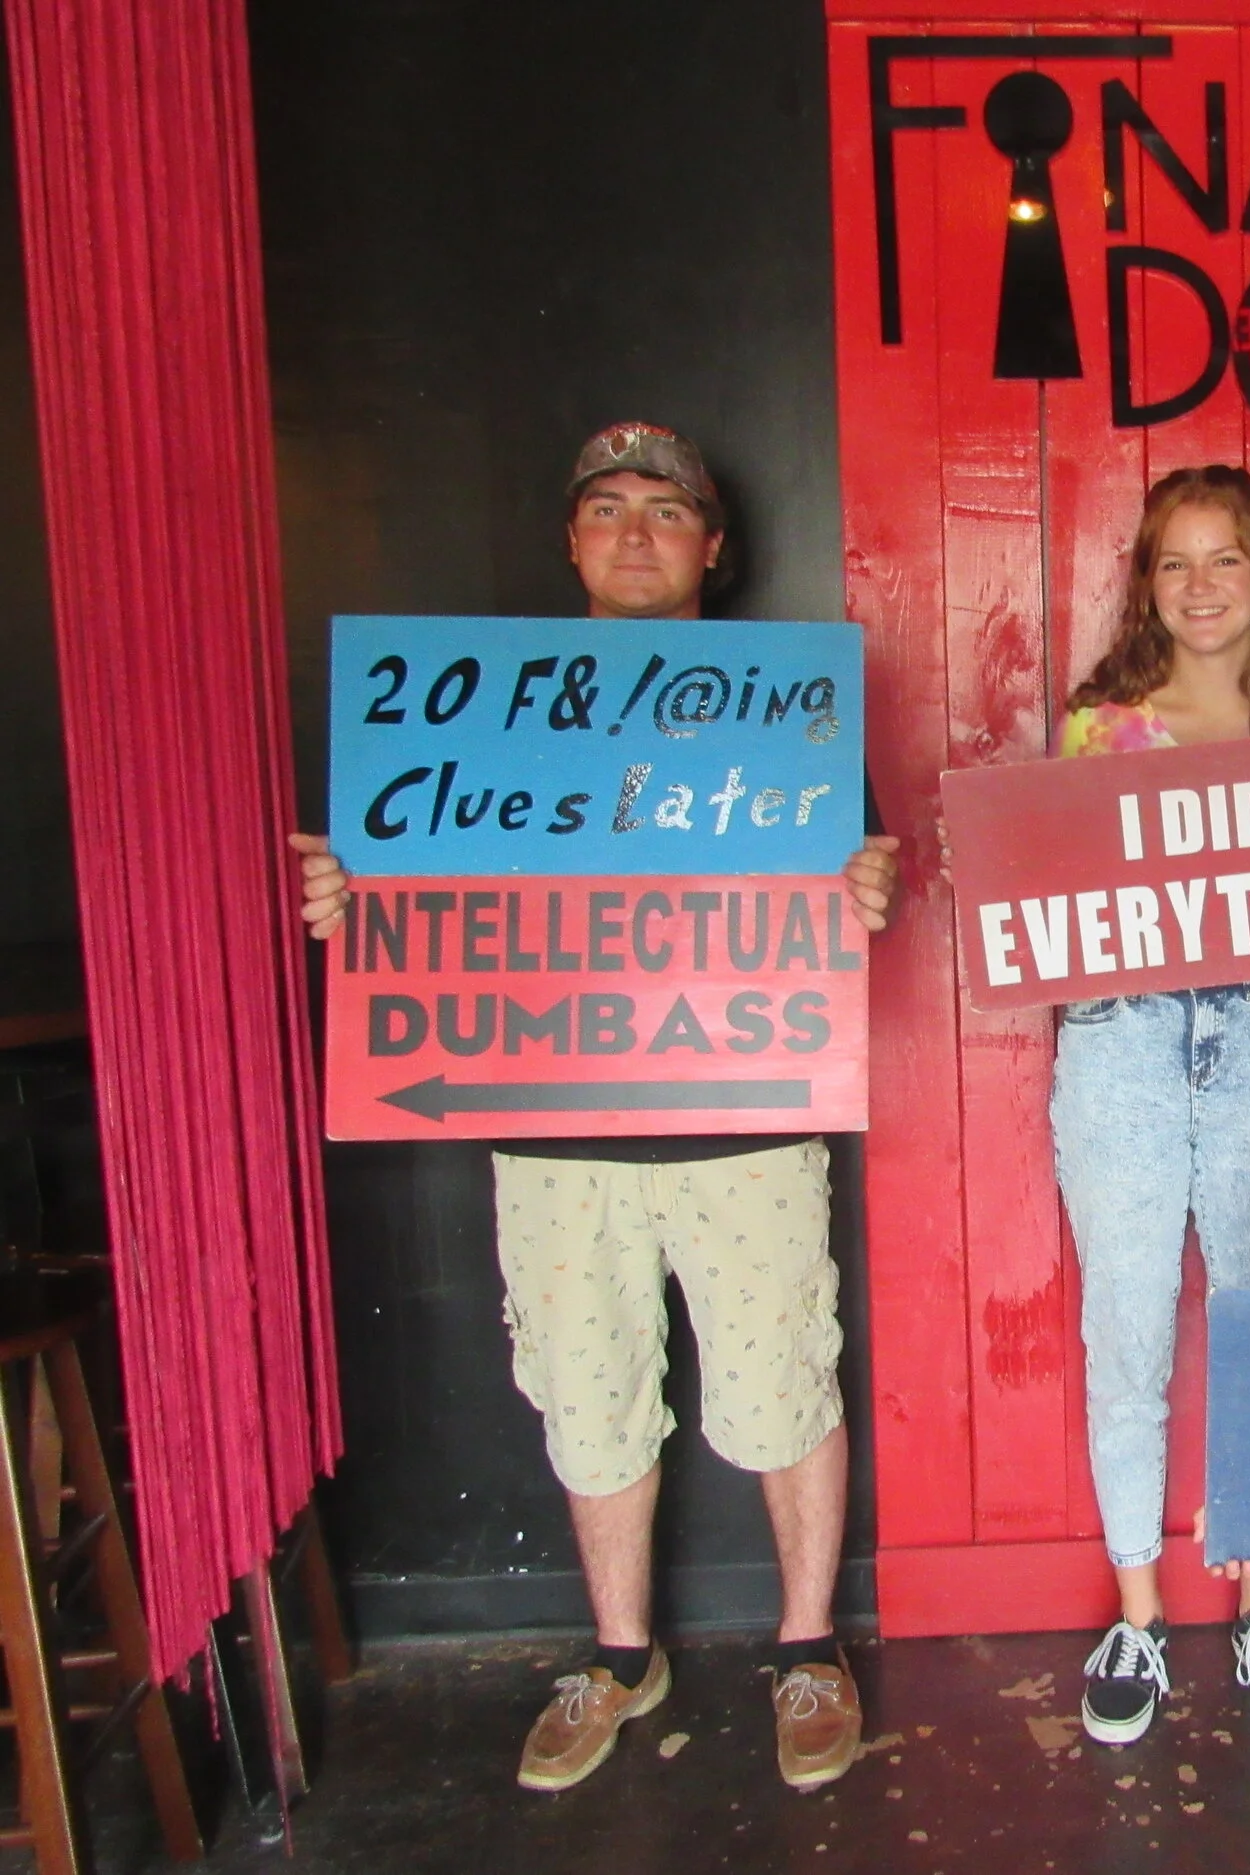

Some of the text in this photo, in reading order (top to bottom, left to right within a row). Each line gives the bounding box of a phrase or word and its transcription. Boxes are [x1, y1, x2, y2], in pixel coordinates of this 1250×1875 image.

[363, 654, 481, 727] 20
[363, 760, 832, 840] Clues Later
[1119, 793, 1144, 861] I
[343, 890, 862, 974] INTELLECTUAL
[367, 990, 833, 1058] DUMBASS
